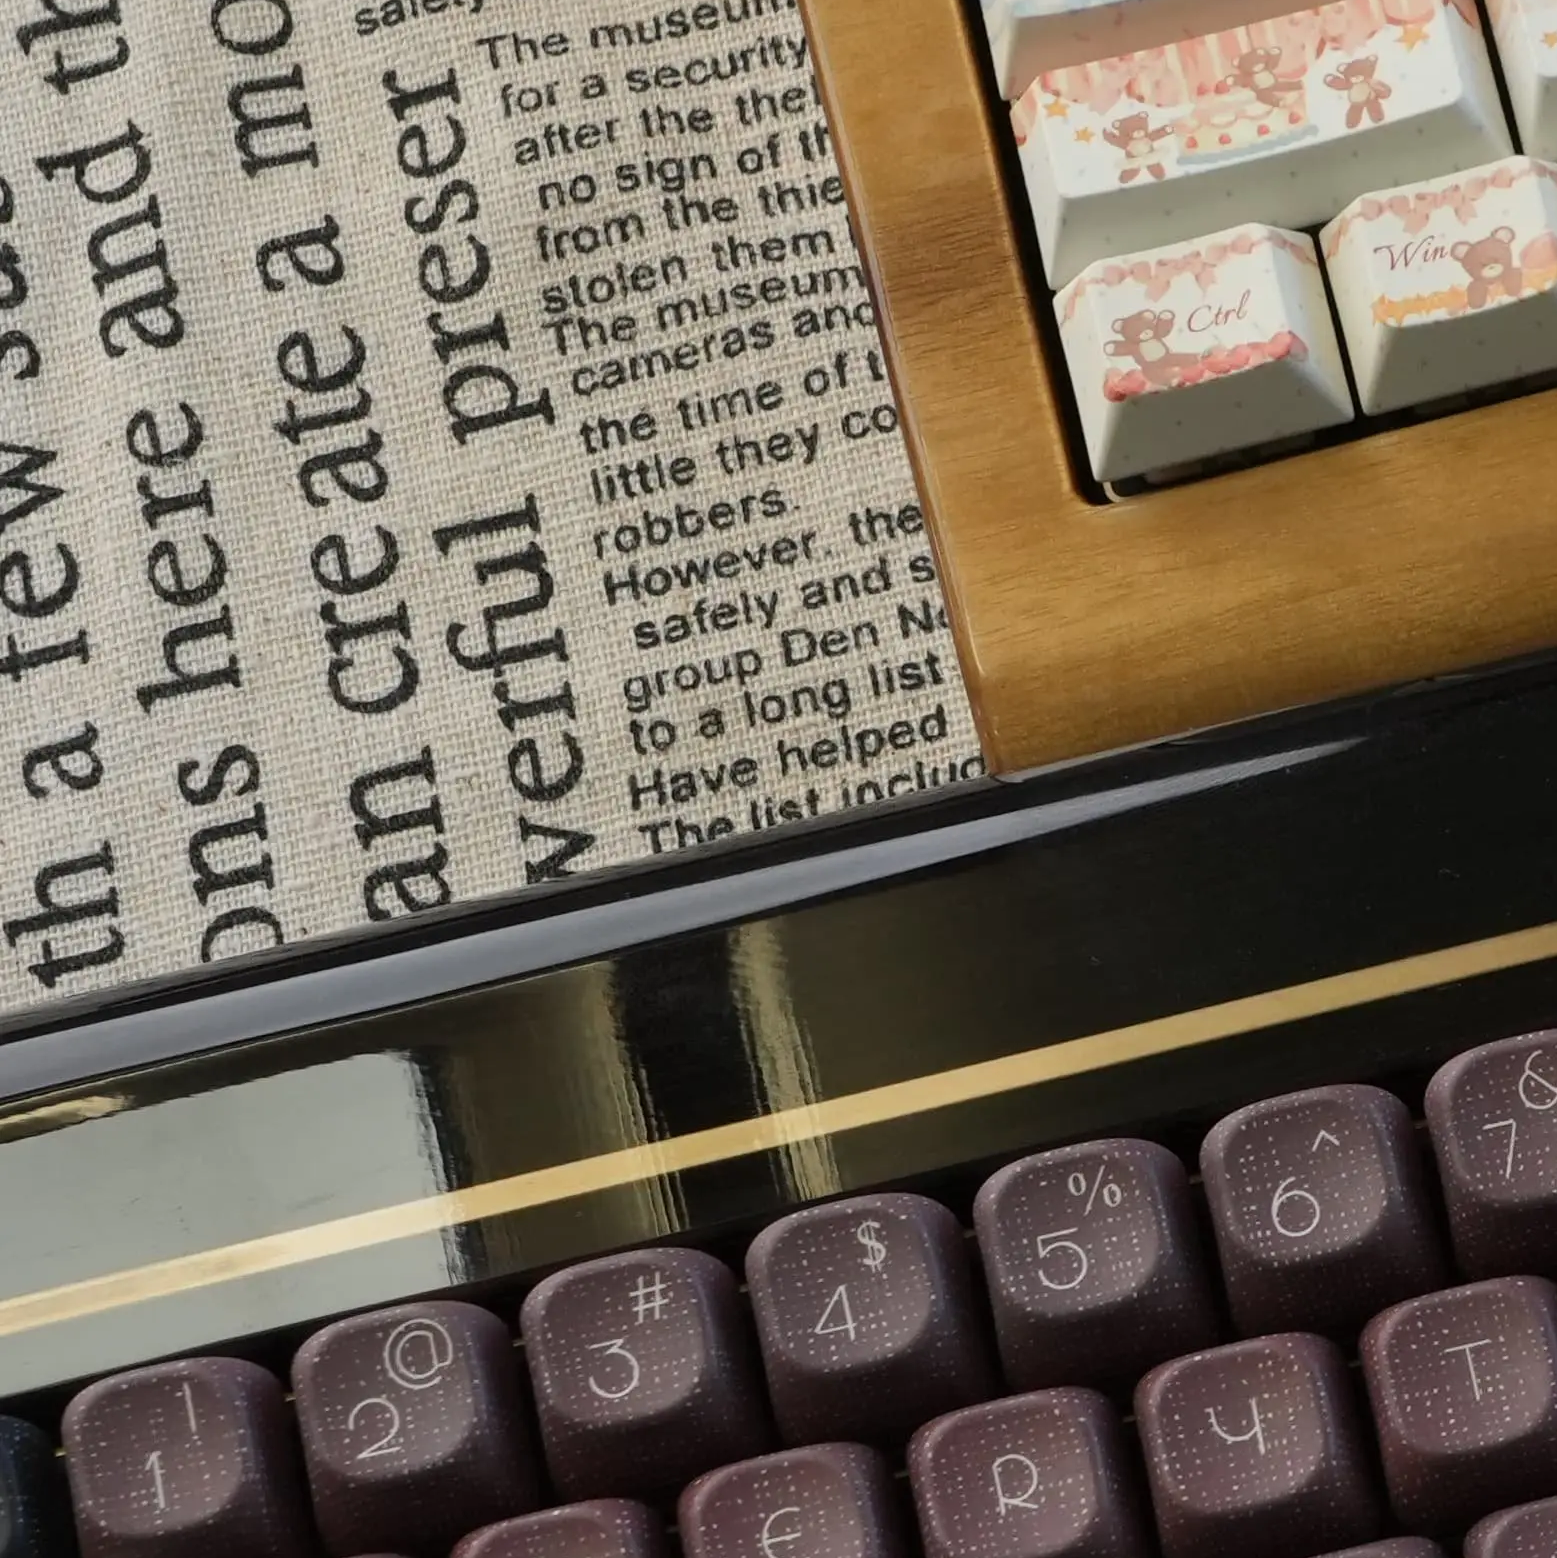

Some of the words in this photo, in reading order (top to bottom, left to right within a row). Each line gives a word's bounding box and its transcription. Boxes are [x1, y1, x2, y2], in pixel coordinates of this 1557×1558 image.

[477, 29, 571, 70] The
[501, 83, 559, 117] for
[626, 38, 807, 94] security
[515, 114, 621, 165] after
[641, 103, 715, 137] the
[616, 149, 717, 194] sign
[737, 134, 778, 174] of
[36, 122, 187, 358] and
[255, 215, 345, 293] a
[381, 68, 555, 448] preser
[535, 211, 645, 263] from
[663, 196, 738, 230] the
[1374, 237, 1449, 273] Win
[541, 254, 688, 314] stolen
[712, 228, 836, 271] them
[1187, 292, 1250, 335] Ctrl
[572, 318, 775, 396] cameras
[678, 381, 782, 431] time
[591, 453, 696, 504] little
[717, 423, 818, 475] they
[125, 401, 241, 715] here
[800, 557, 892, 610] and
[623, 649, 763, 714] group
[782, 619, 880, 668] Den
[744, 678, 852, 727] long
[868, 650, 944, 696] list
[22, 723, 105, 795] a
[629, 756, 758, 810] Have
[777, 704, 948, 775] helped
[1444, 1339, 1492, 1401] T
[992, 1453, 1039, 1516] R
